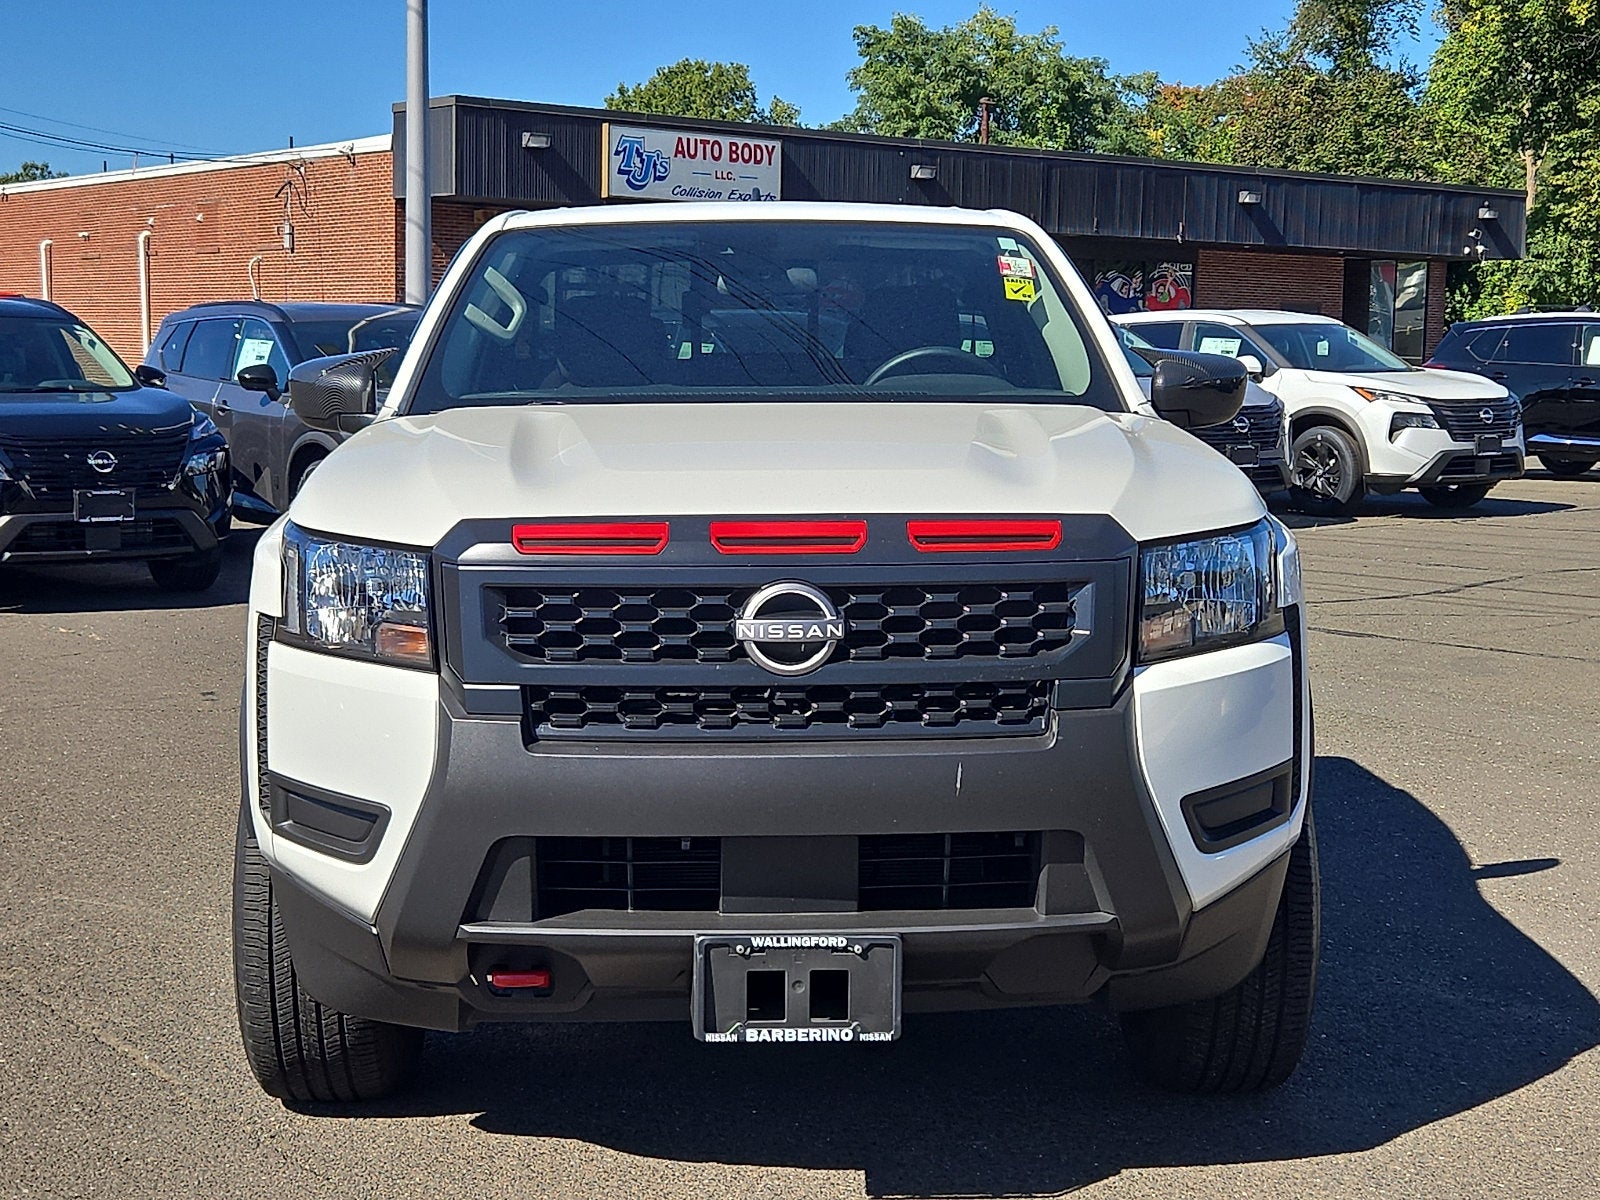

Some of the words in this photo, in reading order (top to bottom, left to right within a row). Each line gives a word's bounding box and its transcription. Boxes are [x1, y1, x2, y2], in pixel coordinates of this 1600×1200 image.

[673, 136, 723, 162] AUTO
[728, 141, 776, 166] BODY
[714, 170, 736, 182] LLC.
[671, 185, 723, 199] Collision
[727, 189, 777, 201] Exprts
[738, 623, 843, 639] NISSAN
[751, 936, 848, 948] WALLINGFORD
[705, 1034, 738, 1042] NISSAN
[745, 1028, 854, 1042] BARBERINO
